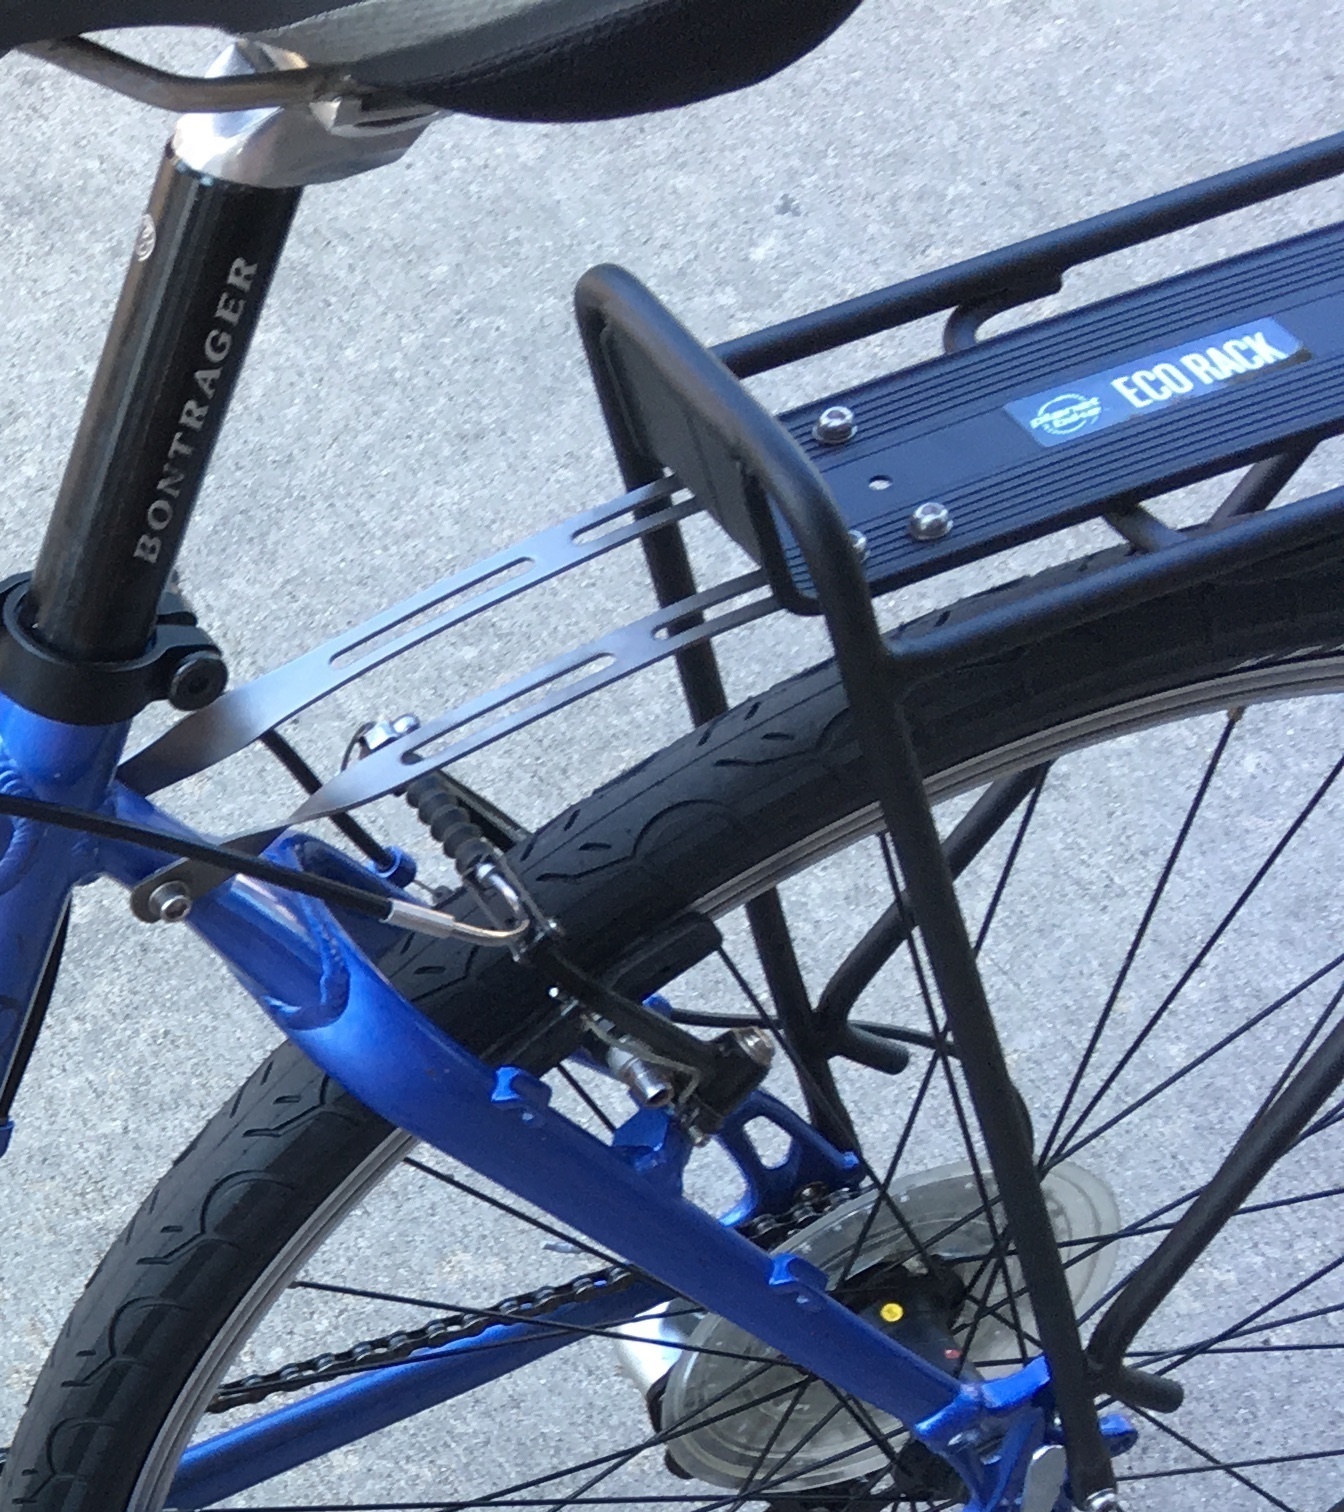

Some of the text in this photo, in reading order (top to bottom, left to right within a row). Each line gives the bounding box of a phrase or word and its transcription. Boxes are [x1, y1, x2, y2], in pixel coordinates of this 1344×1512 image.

[134, 256, 258, 564] BONTRAGER
[1111, 331, 1289, 408] ECO RACK
